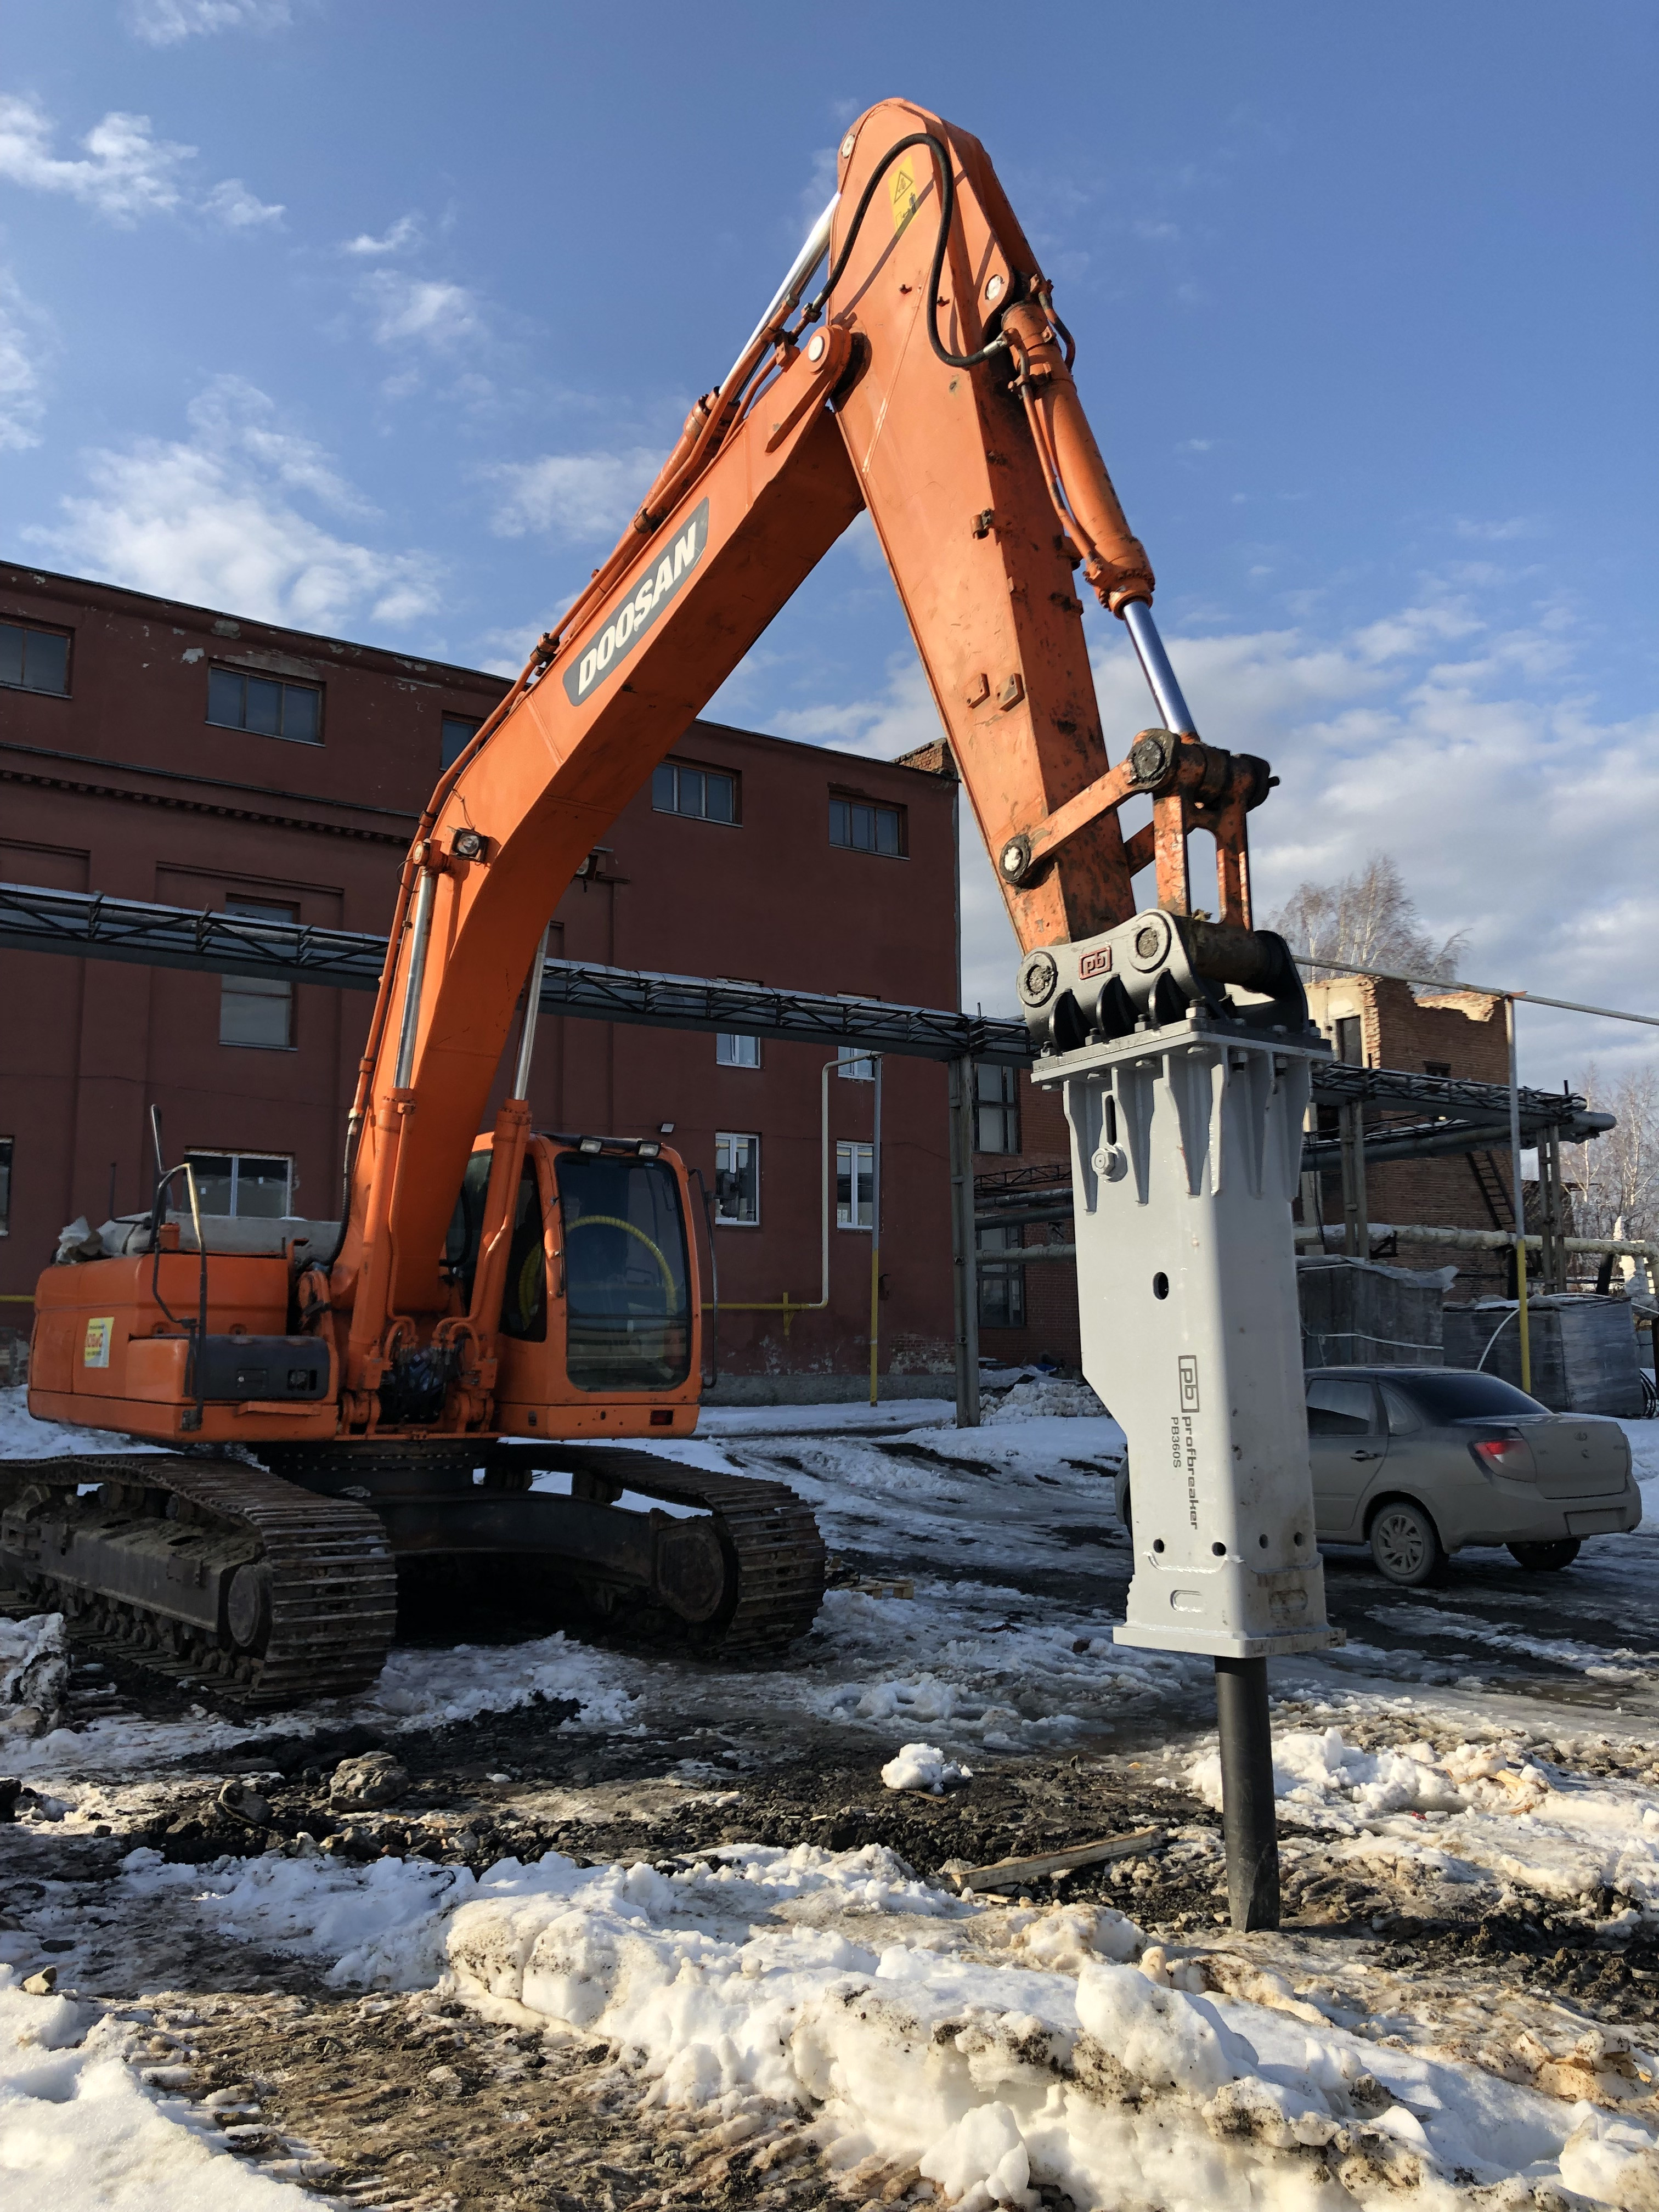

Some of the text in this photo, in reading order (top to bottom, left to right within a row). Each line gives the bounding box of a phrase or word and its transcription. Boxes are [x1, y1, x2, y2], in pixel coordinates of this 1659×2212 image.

[578, 521, 697, 696] DOOSAN
[1171, 1417, 1181, 1468] PB360S
[1182, 1416, 1199, 1530] profbreaker
